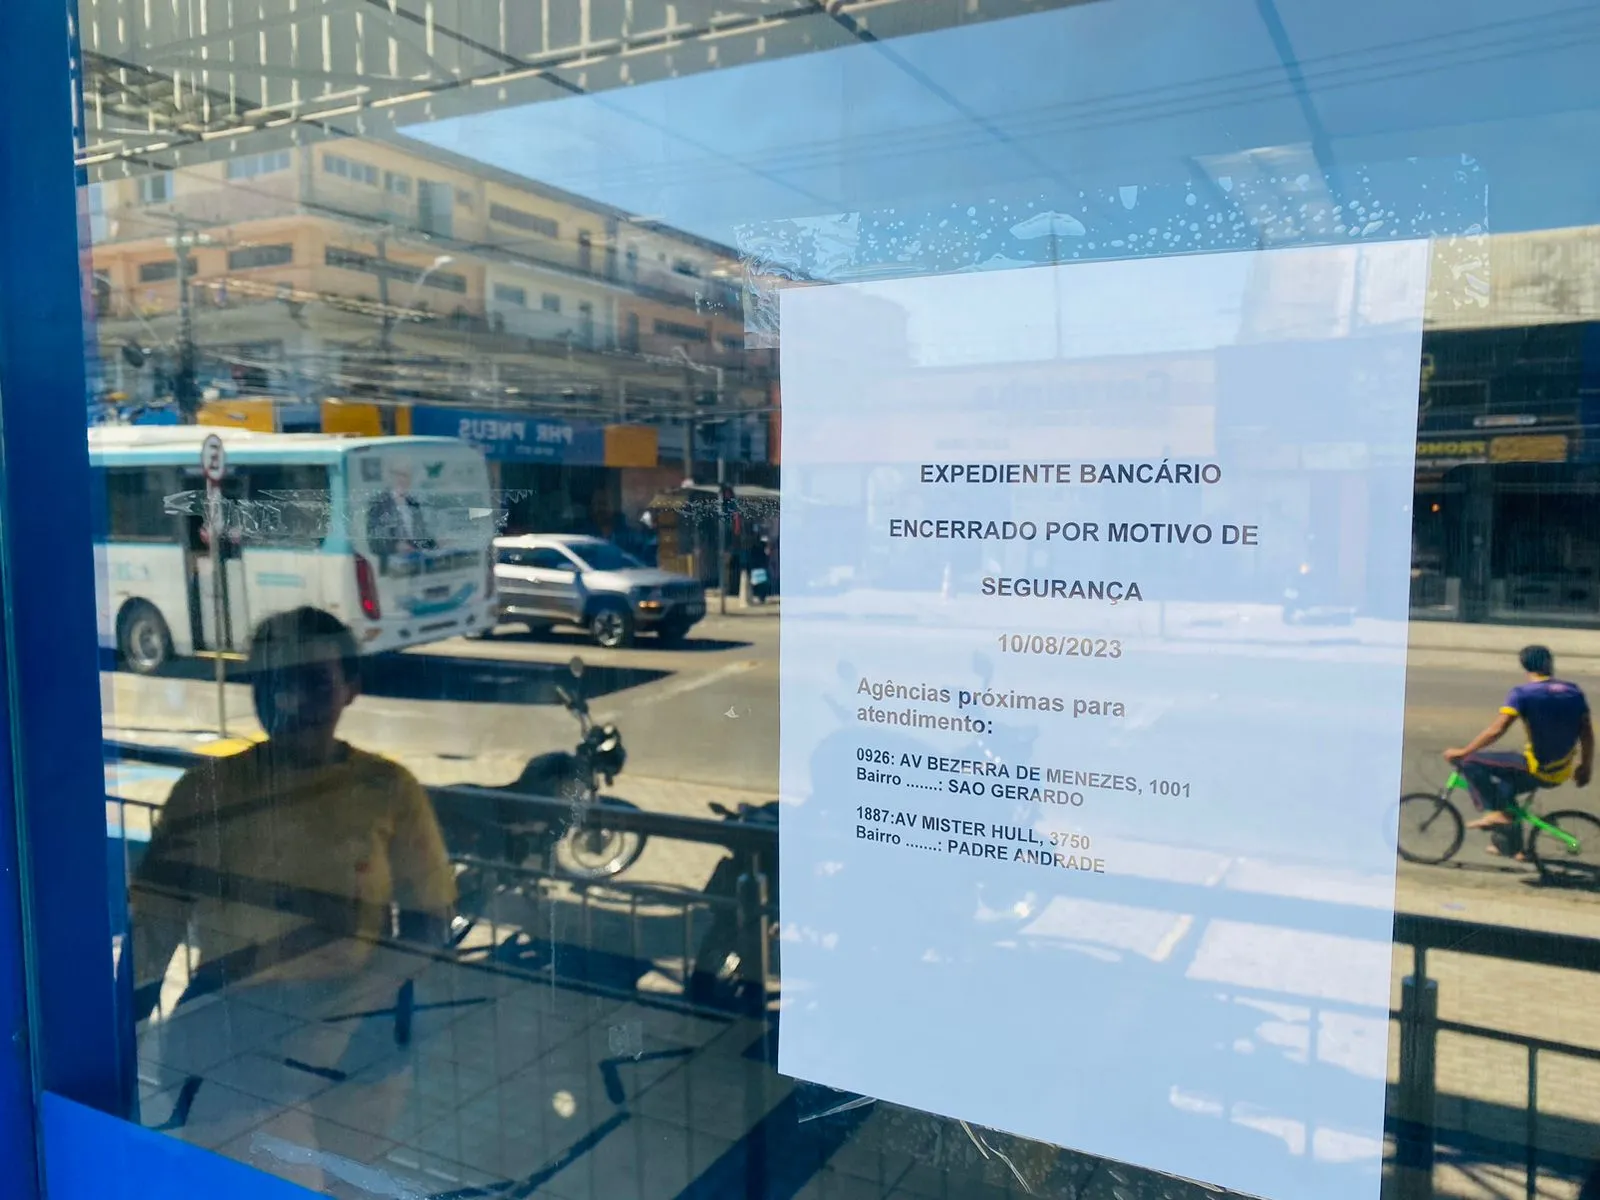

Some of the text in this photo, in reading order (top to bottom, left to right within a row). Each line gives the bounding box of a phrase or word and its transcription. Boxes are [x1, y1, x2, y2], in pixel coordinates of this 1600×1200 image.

[920, 458, 1222, 484] EXPEDIENTE BANCÁRIO
[889, 519, 1259, 545] ENCERRADO POR MOTIVO DE
[981, 577, 1143, 605] SEGURANÇA
[998, 634, 1123, 658] 10/08/2023
[857, 677, 1126, 718] Agências próximas para
[857, 705, 993, 735] atendimento:
[856, 747, 1192, 798] 0926: AV BEZERRA DE MENEZES, 1001
[856, 767, 902, 786] Bairro
[948, 779, 986, 797] SAO
[991, 783, 1084, 807] GERARDO
[857, 806, 1090, 850] 1887:AV MISTER HULL, 3750
[856, 826, 901, 845] Bairro
[948, 839, 1008, 861] PADRE
[1013, 850, 1105, 874] ANDRADE
